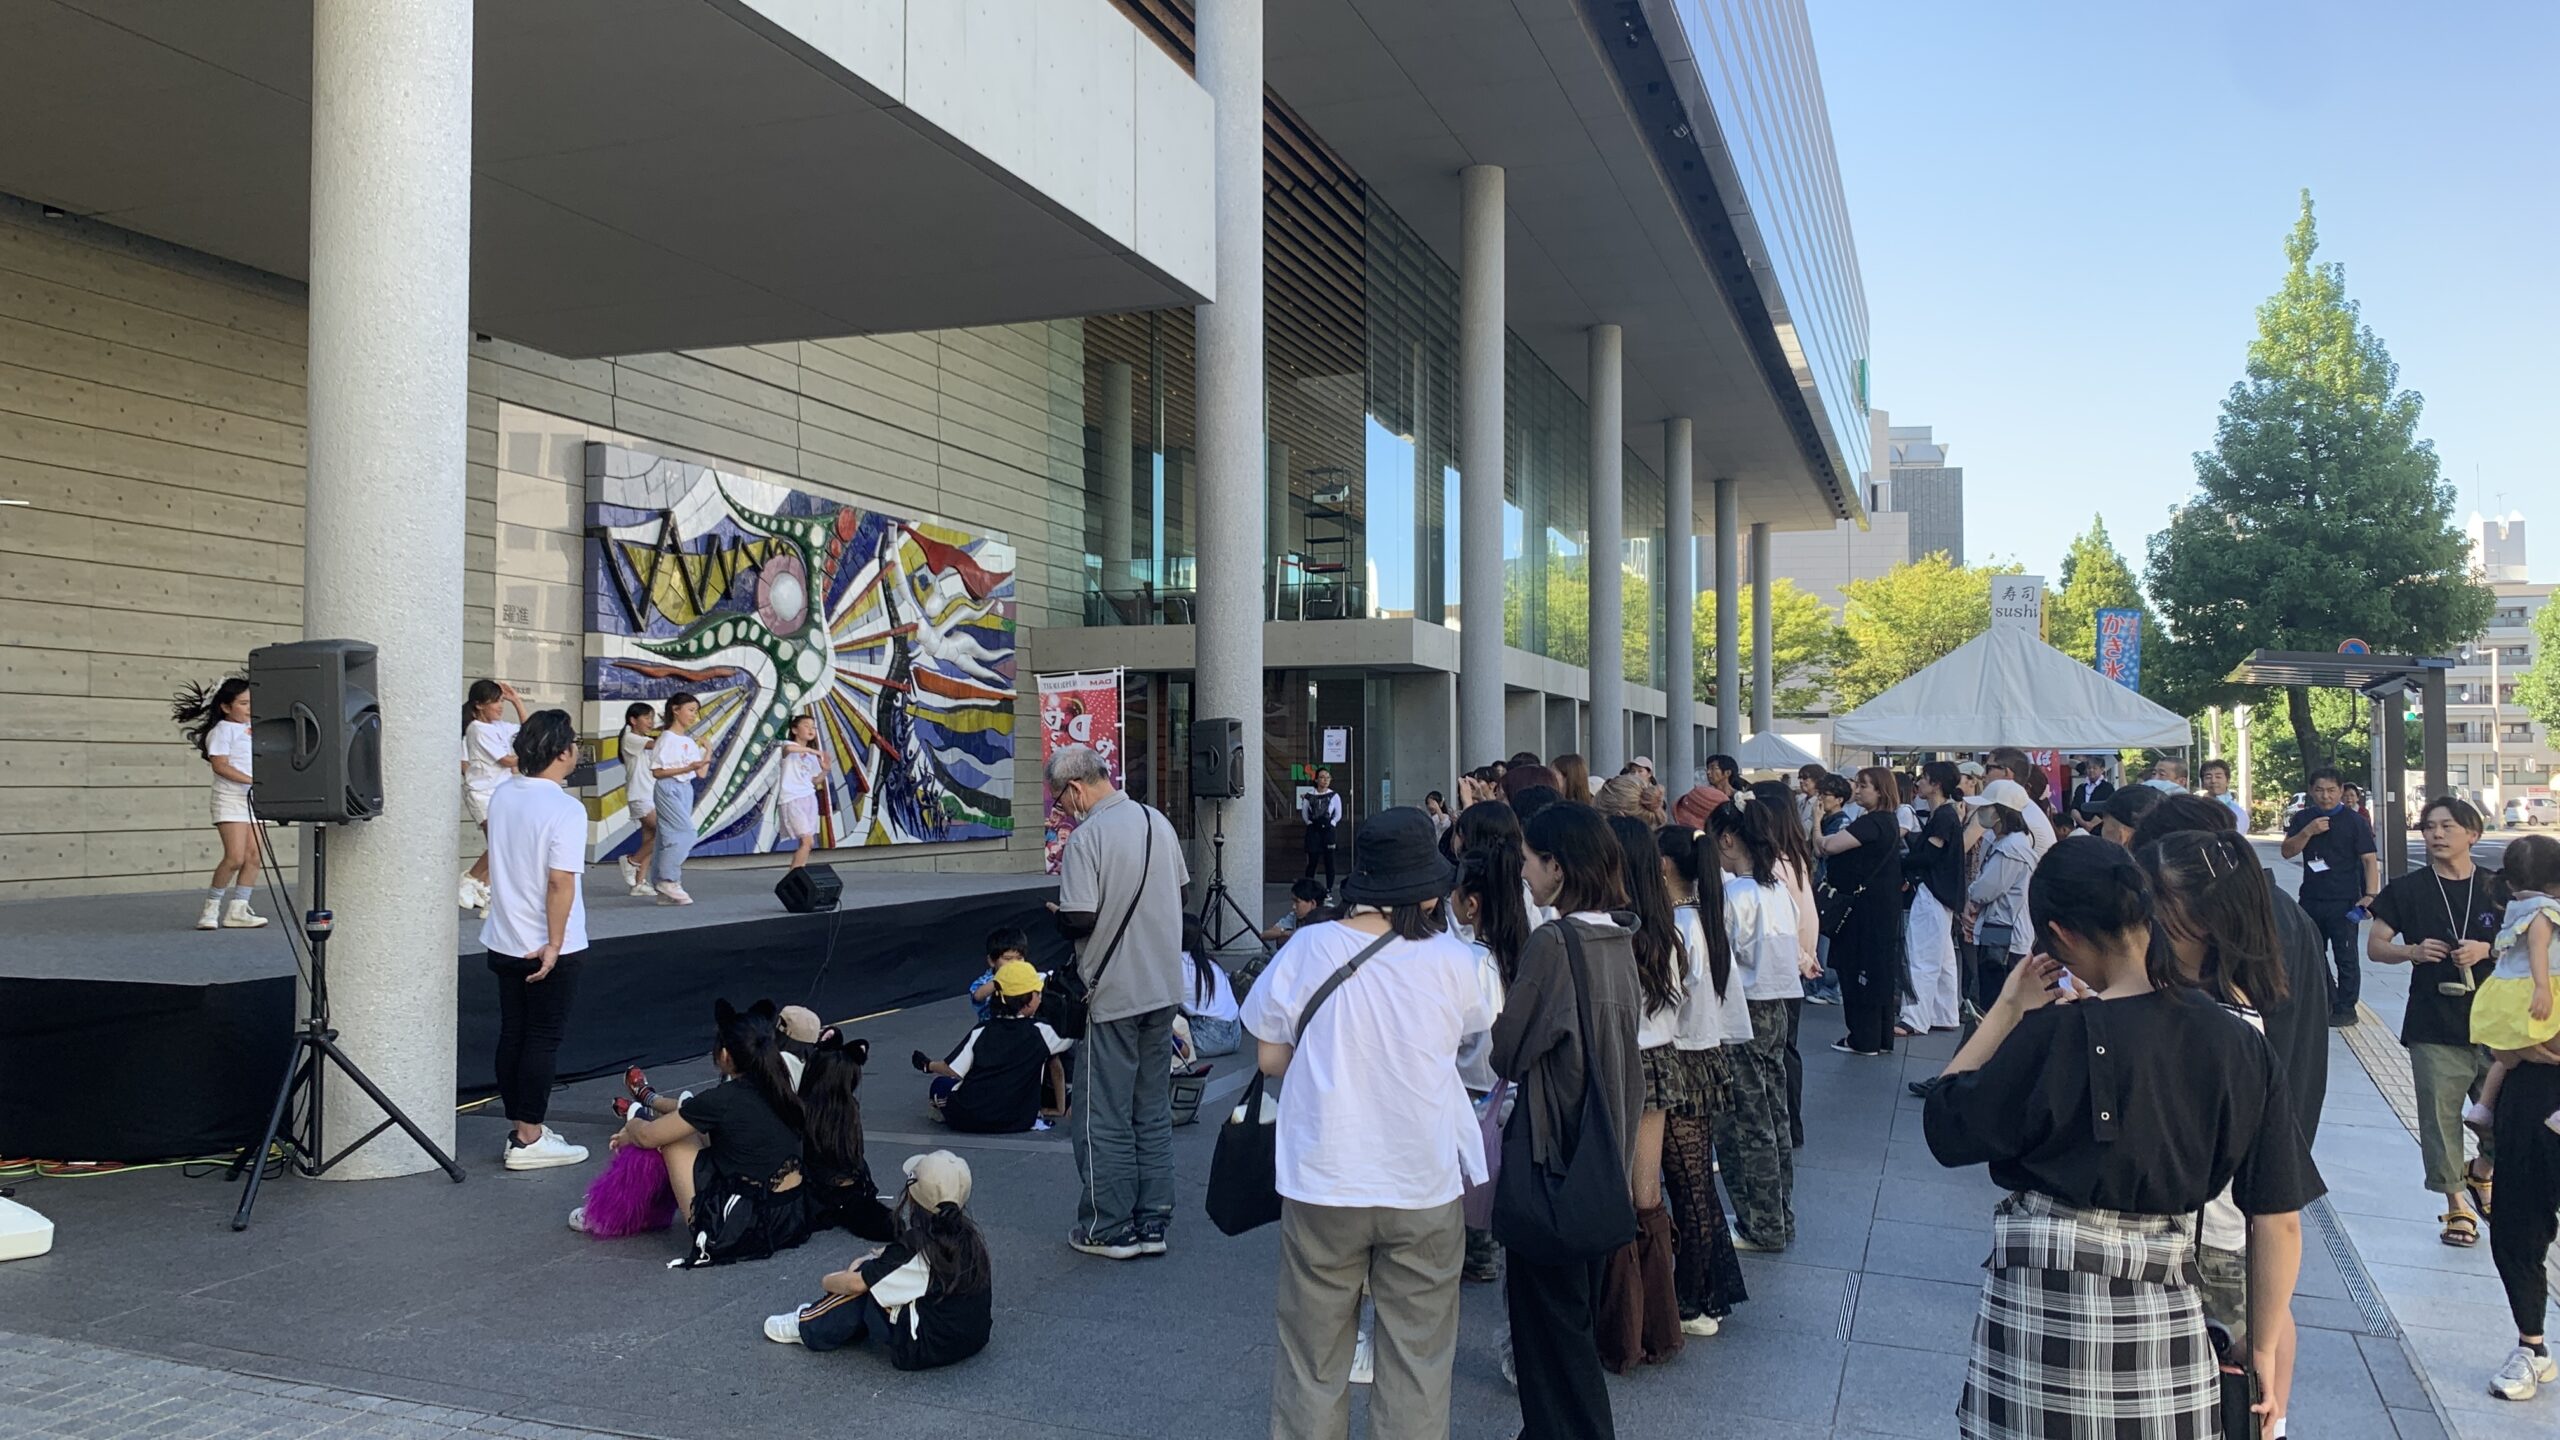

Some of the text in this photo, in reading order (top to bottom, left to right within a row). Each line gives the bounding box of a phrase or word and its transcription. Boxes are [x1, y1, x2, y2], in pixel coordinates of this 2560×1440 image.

[2001, 586, 2035, 601] 寿司
[502, 604, 529, 625] 躍進
[1995, 604, 2038, 618] sushi
[2102, 613, 2126, 681] かき氷
